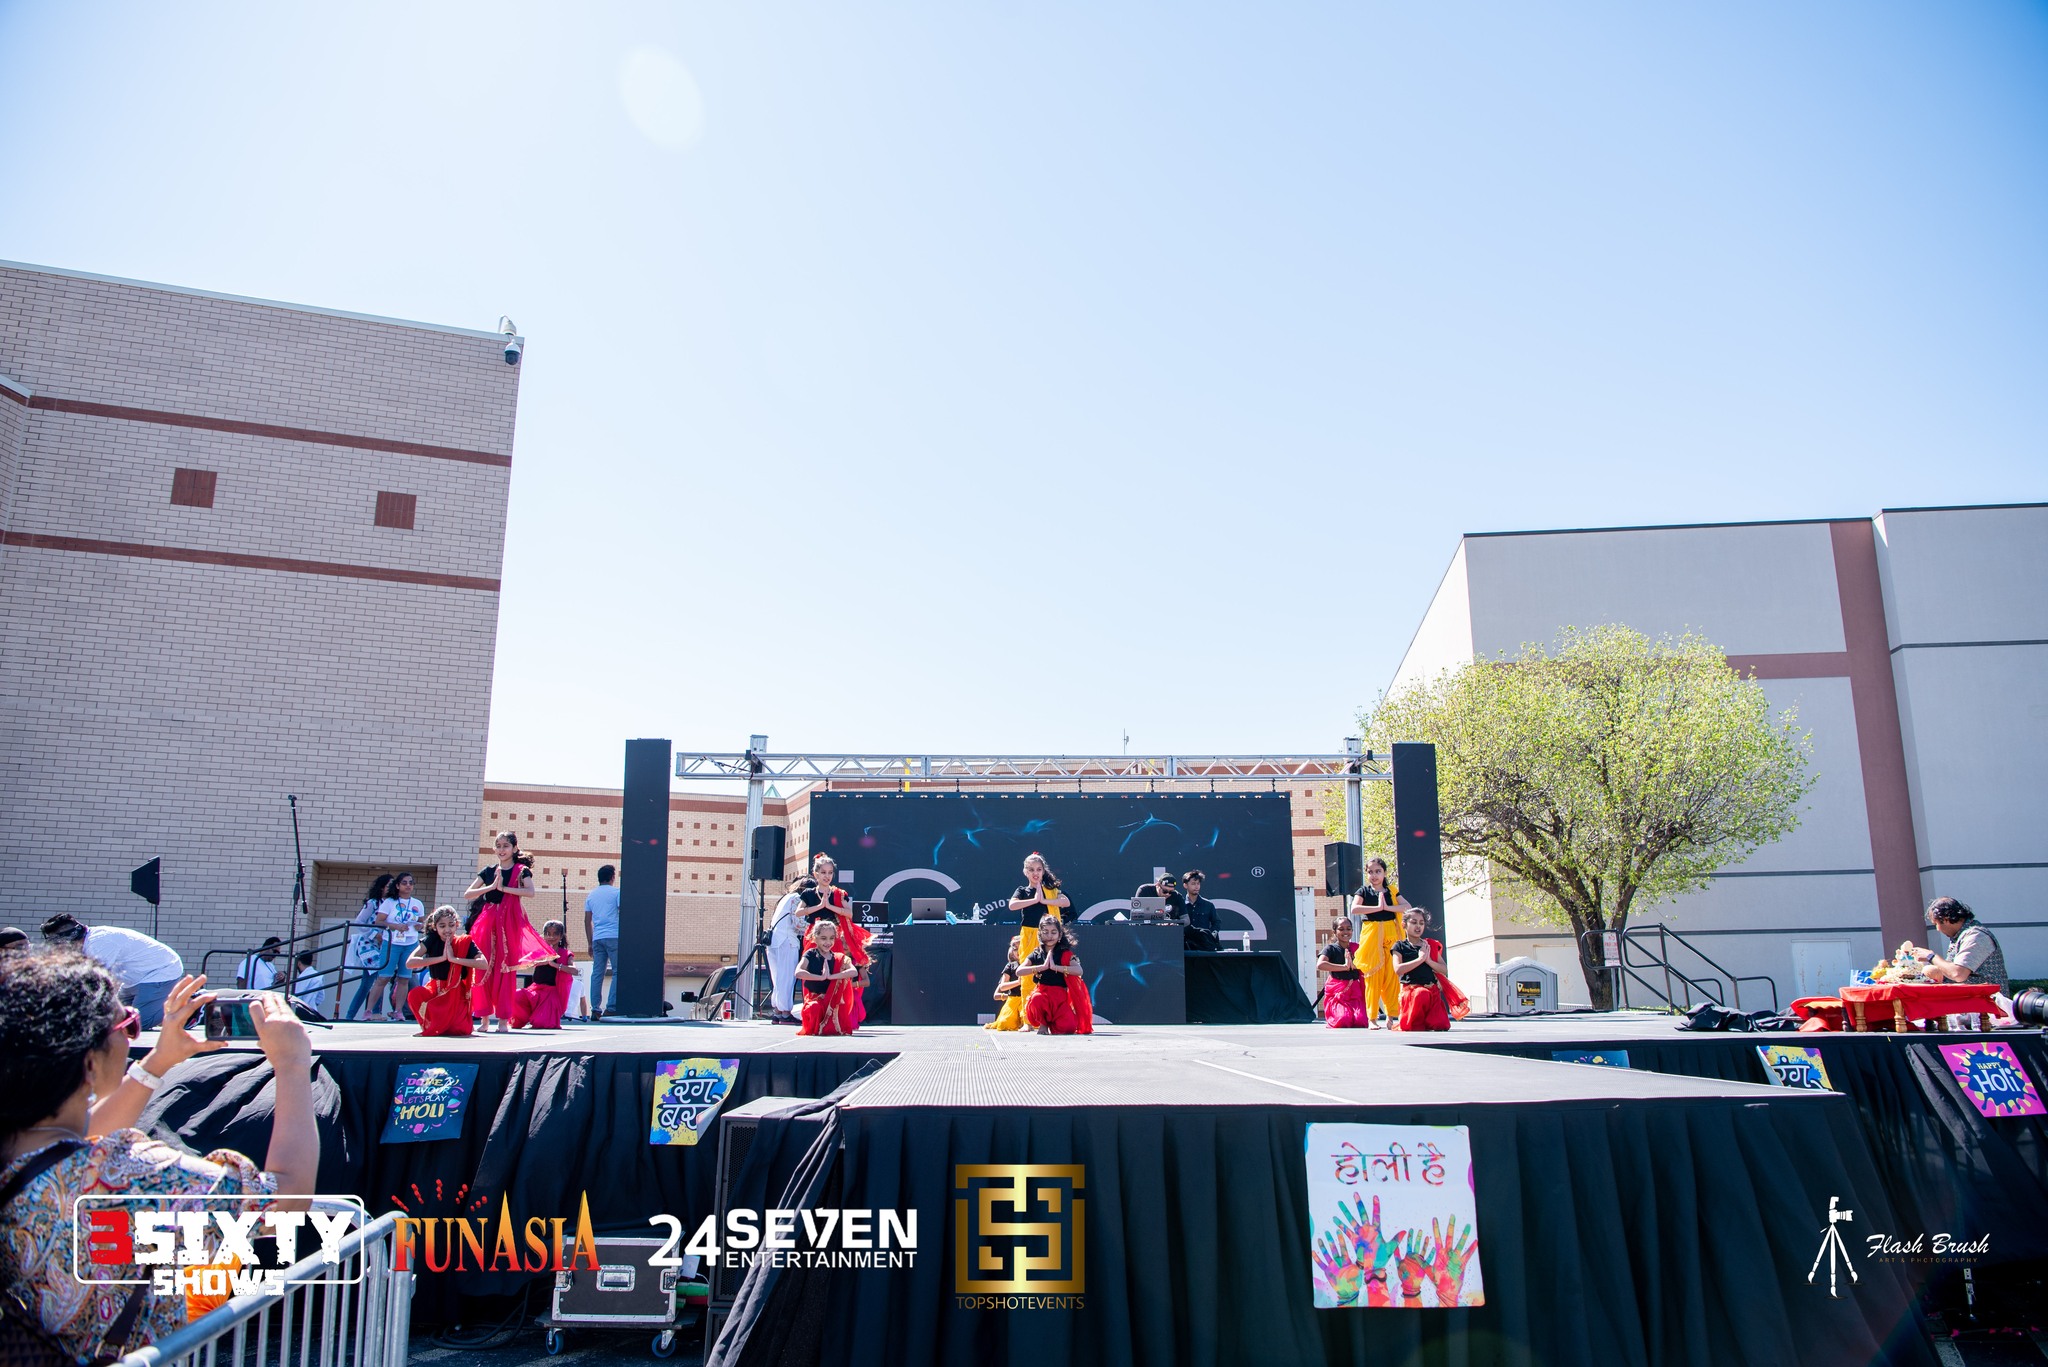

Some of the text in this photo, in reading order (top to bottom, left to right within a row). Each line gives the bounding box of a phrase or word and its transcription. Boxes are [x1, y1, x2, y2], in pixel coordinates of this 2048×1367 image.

[674, 1070, 719, 1104] रंग
[400, 1103, 444, 1120] HOLI
[1331, 1142, 1446, 1186] होली है
